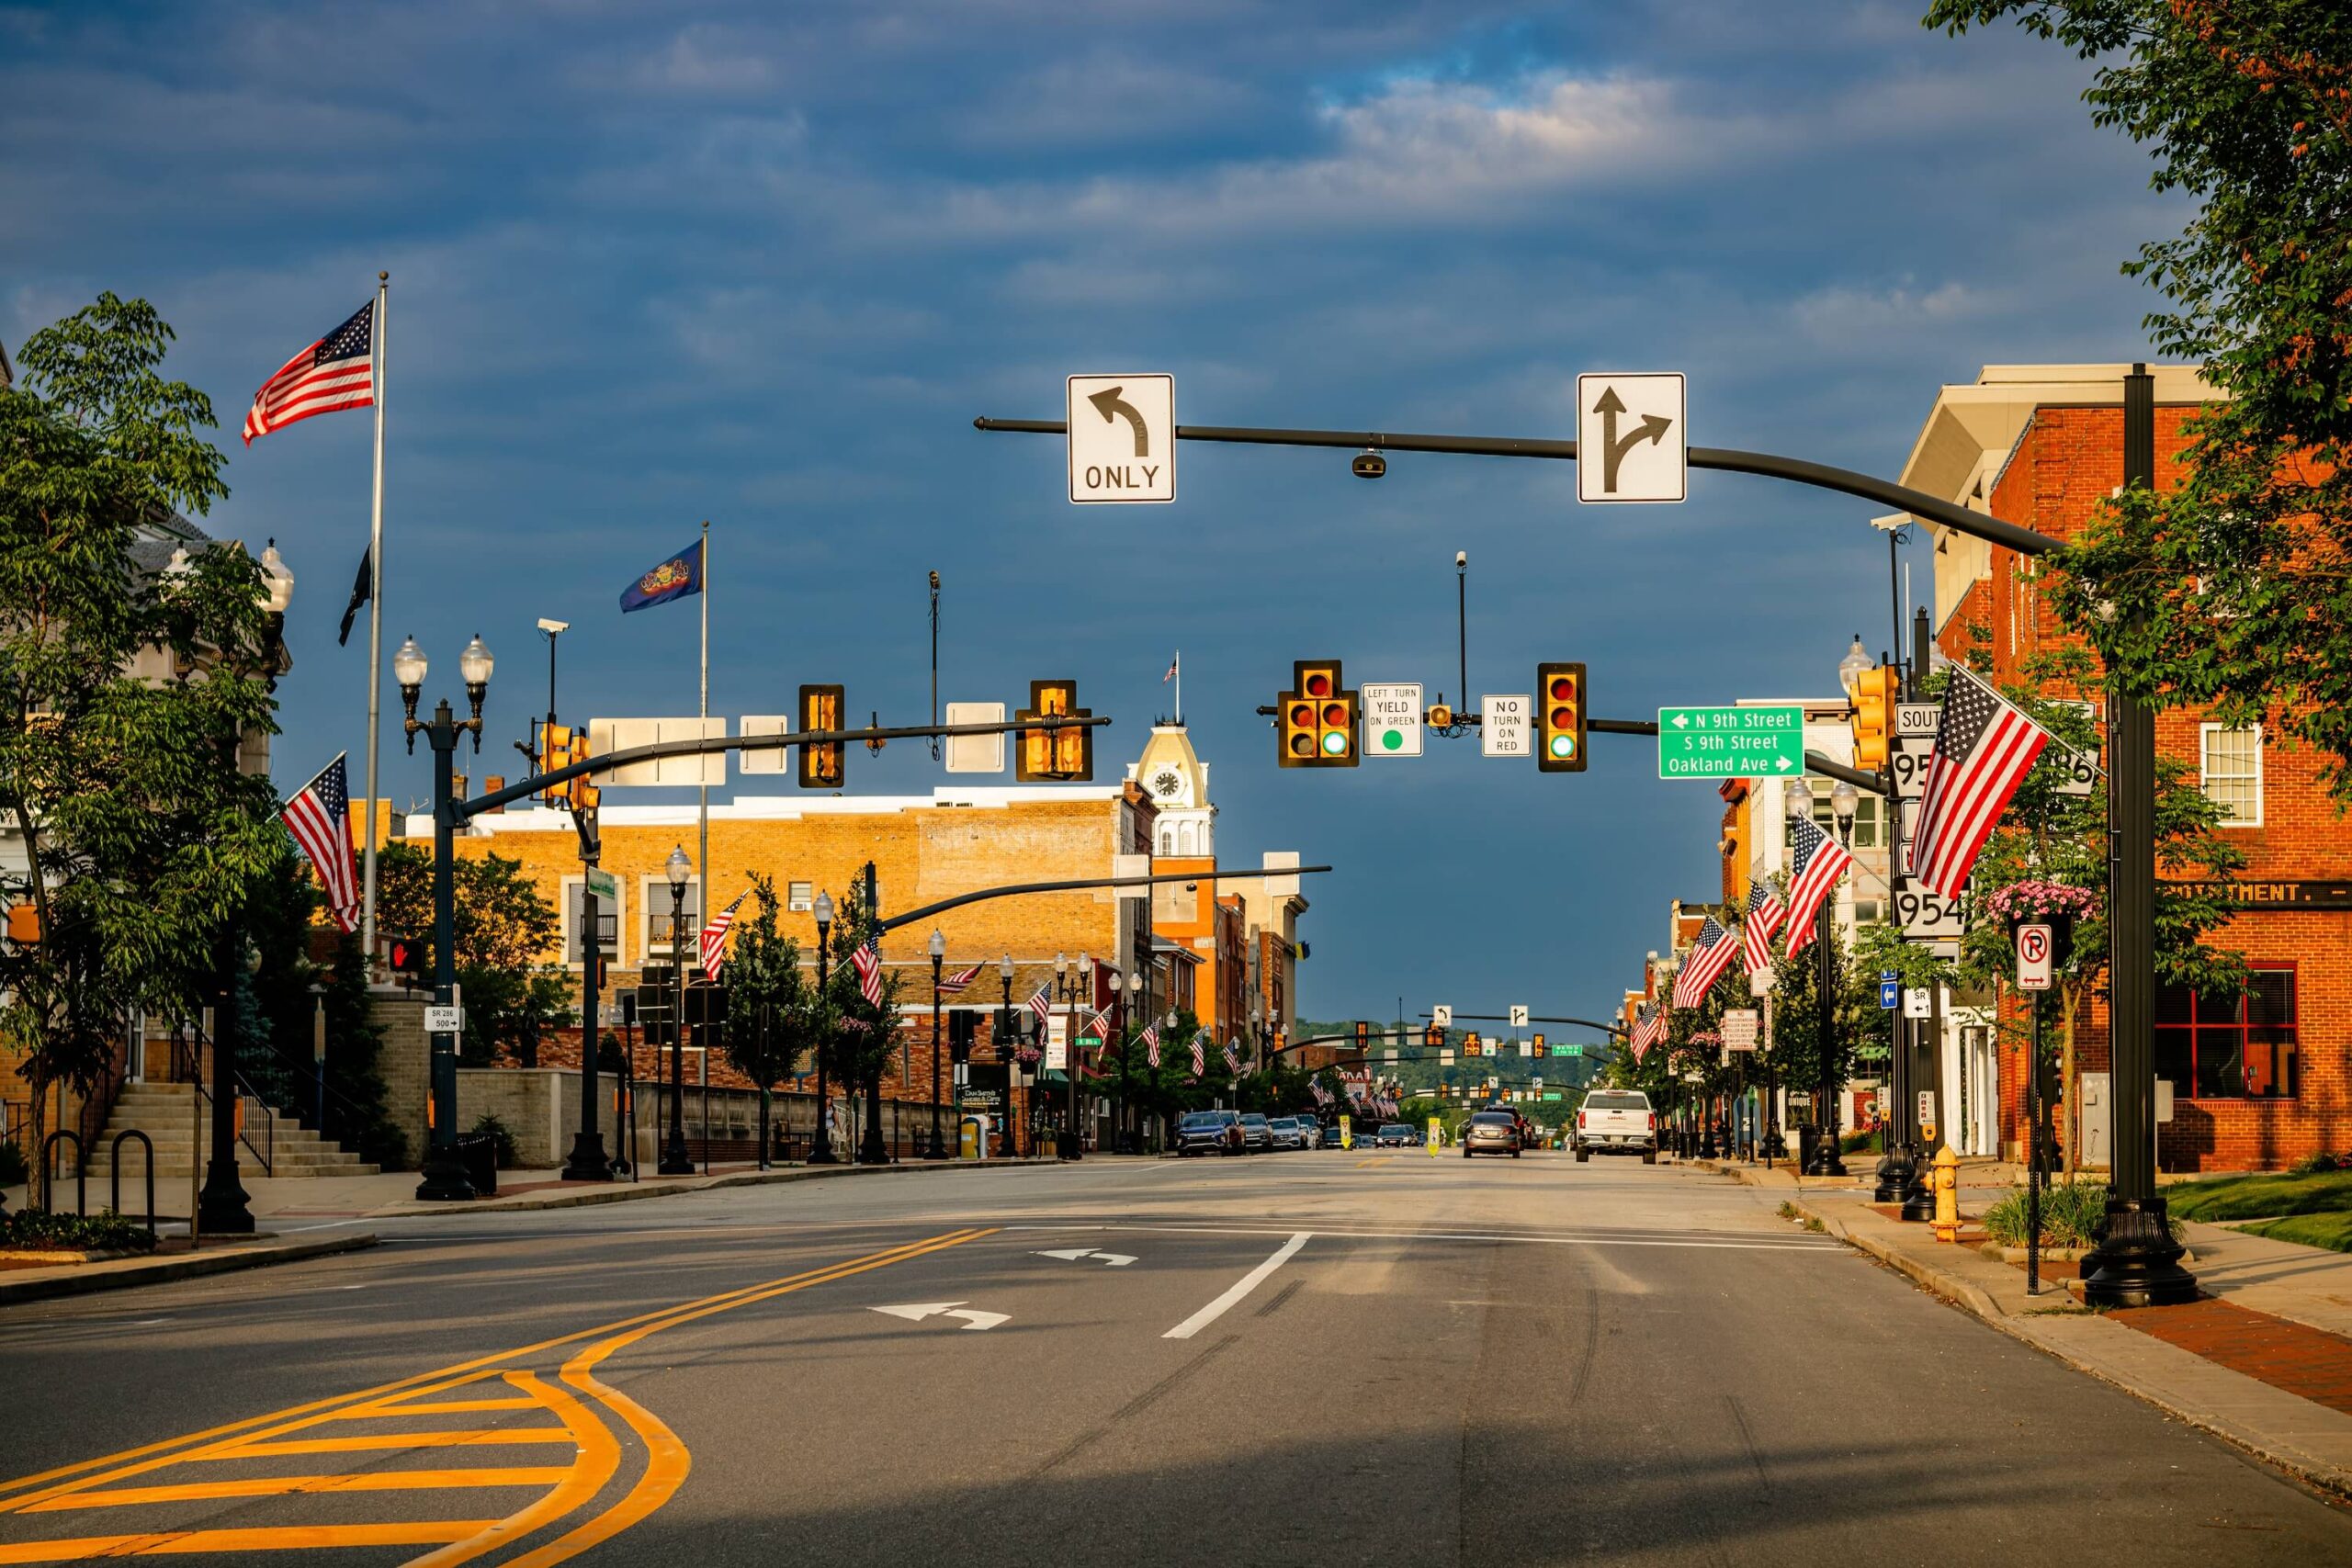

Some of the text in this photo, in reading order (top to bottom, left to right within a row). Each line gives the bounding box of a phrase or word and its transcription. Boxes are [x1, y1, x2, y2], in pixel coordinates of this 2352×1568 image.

[1085, 465, 1159, 489] ONLY
[1368, 689, 1417, 698] LEFT TURN
[1376, 702, 1408, 713] YIELD
[1496, 702, 1518, 713] NO
[1370, 716, 1415, 726] ON GREEN
[1493, 716, 1521, 725] TURN
[1696, 712, 1792, 728] N 9th Street
[1902, 710, 1941, 728] SOUT
[1498, 729, 1515, 738] ON
[1497, 741, 1518, 750] RED
[1684, 734, 1779, 750] S 9th Street
[1668, 755, 1769, 773] Oakland Ave
[1894, 754, 1932, 785] 95
[1899, 893, 1965, 926] 954
[1914, 991, 1926, 1000] SR
[1788, 1097, 1811, 1107] UNIQUE
